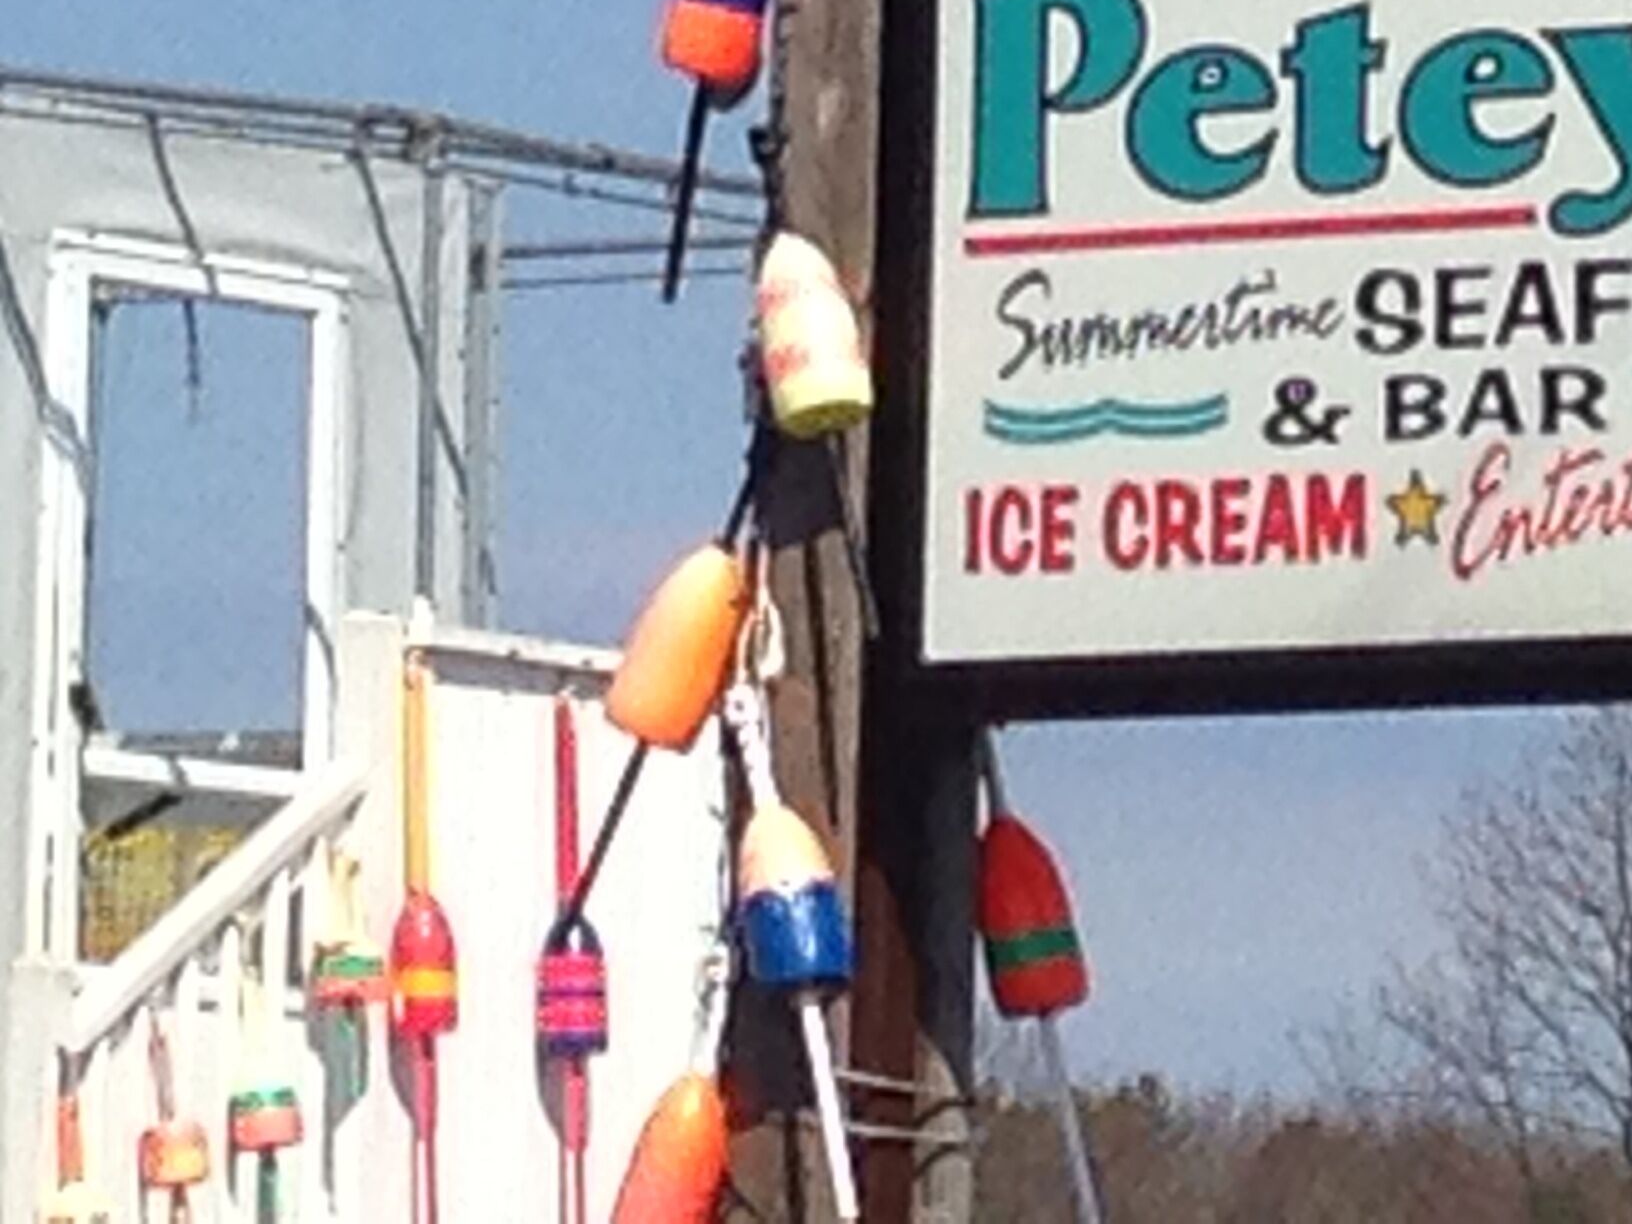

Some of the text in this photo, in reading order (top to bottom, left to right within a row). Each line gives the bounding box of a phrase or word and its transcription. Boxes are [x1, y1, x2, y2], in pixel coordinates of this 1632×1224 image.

[995, 268, 1346, 380] Summertime
[1262, 366, 1608, 446] & BAR
[963, 481, 1076, 576] ICE
[1103, 472, 1370, 569] CREAM
